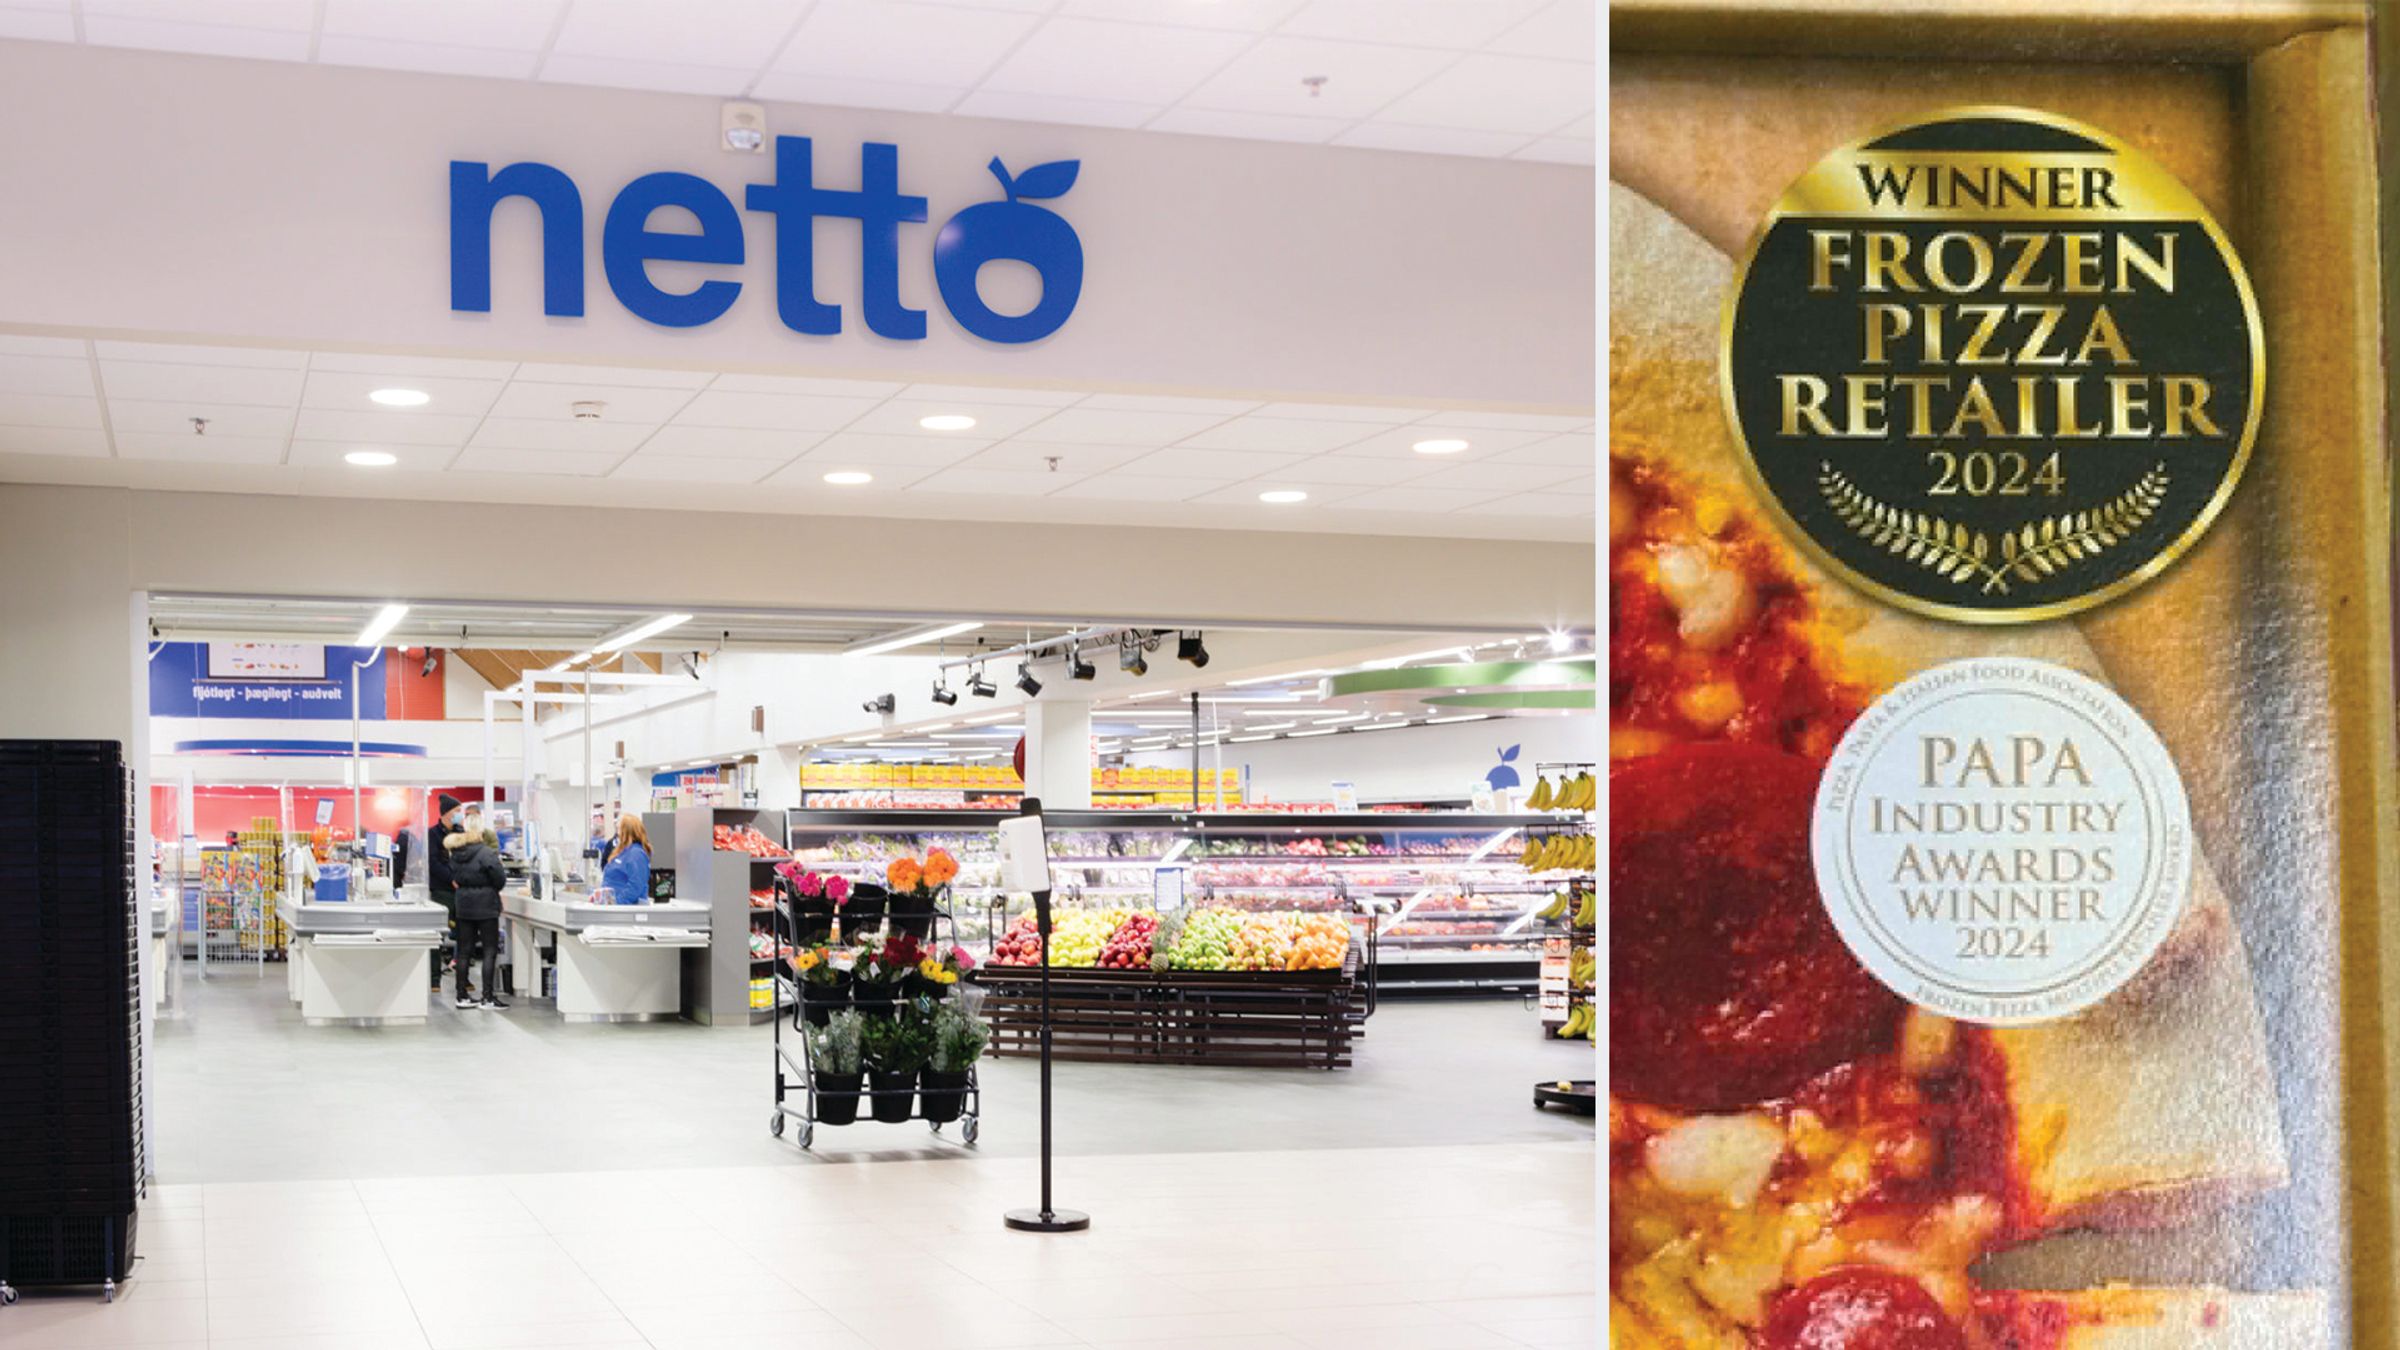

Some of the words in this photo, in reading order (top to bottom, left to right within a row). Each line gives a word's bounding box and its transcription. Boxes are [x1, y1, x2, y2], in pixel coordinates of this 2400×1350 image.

[1856, 163, 2123, 209] WINNER
[450, 135, 1084, 344] netto
[1808, 229, 2179, 293] FROZEN
[1859, 303, 2137, 365] PIZZA
[1776, 374, 2226, 438] RETAILER
[1927, 452, 2066, 496] 2024
[1919, 734, 2094, 788] PAPA
[1869, 796, 2126, 834] INDUSTRY
[1889, 842, 2116, 883] AWARDS
[1898, 888, 2106, 922] WINNER
[1955, 927, 2050, 959] 2024
